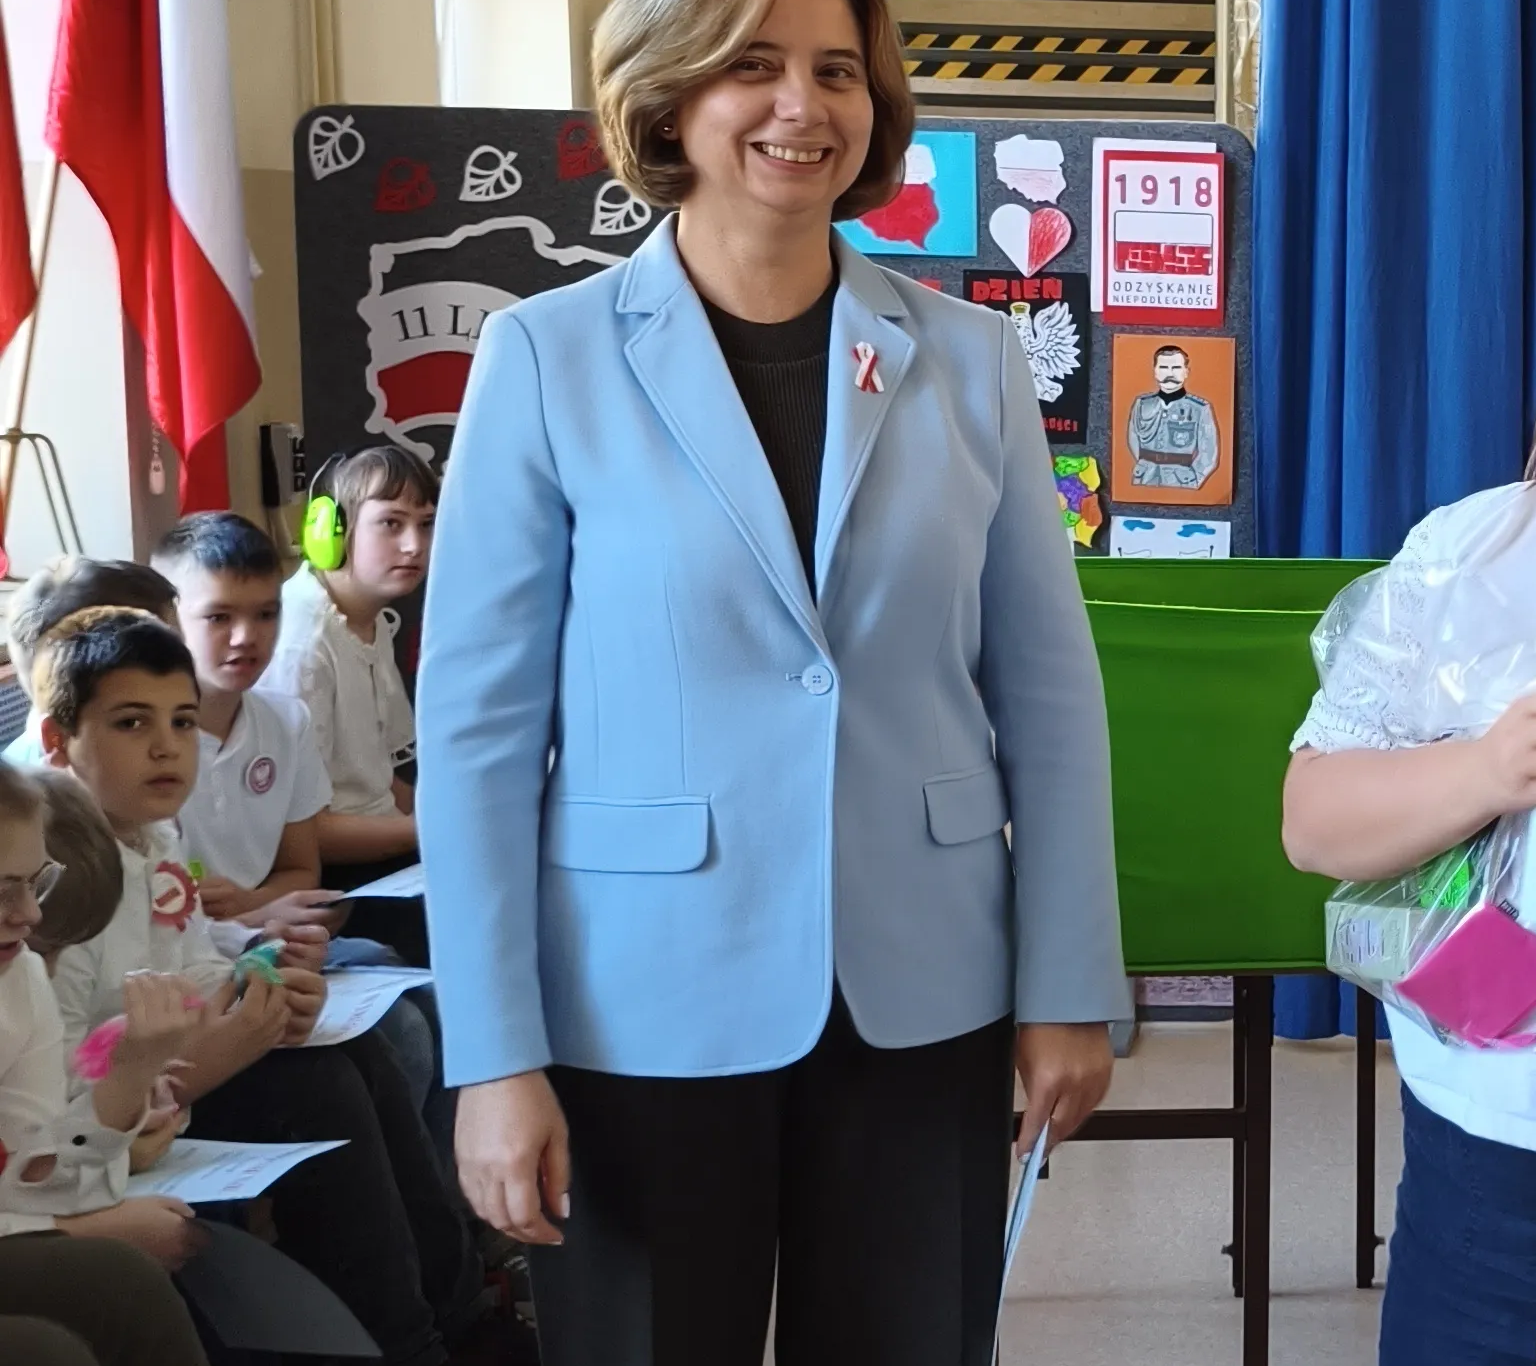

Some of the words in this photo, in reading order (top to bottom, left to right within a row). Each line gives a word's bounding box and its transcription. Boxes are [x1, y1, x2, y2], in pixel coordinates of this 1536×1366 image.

[1114, 174, 1213, 207] 1918
[972, 277, 1063, 302] DZIEŃ
[1112, 294, 1214, 307] NIEPODLEGŁOŚCI
[1113, 281, 1214, 295] ODZYSKANIE
[391, 305, 435, 343] 11
